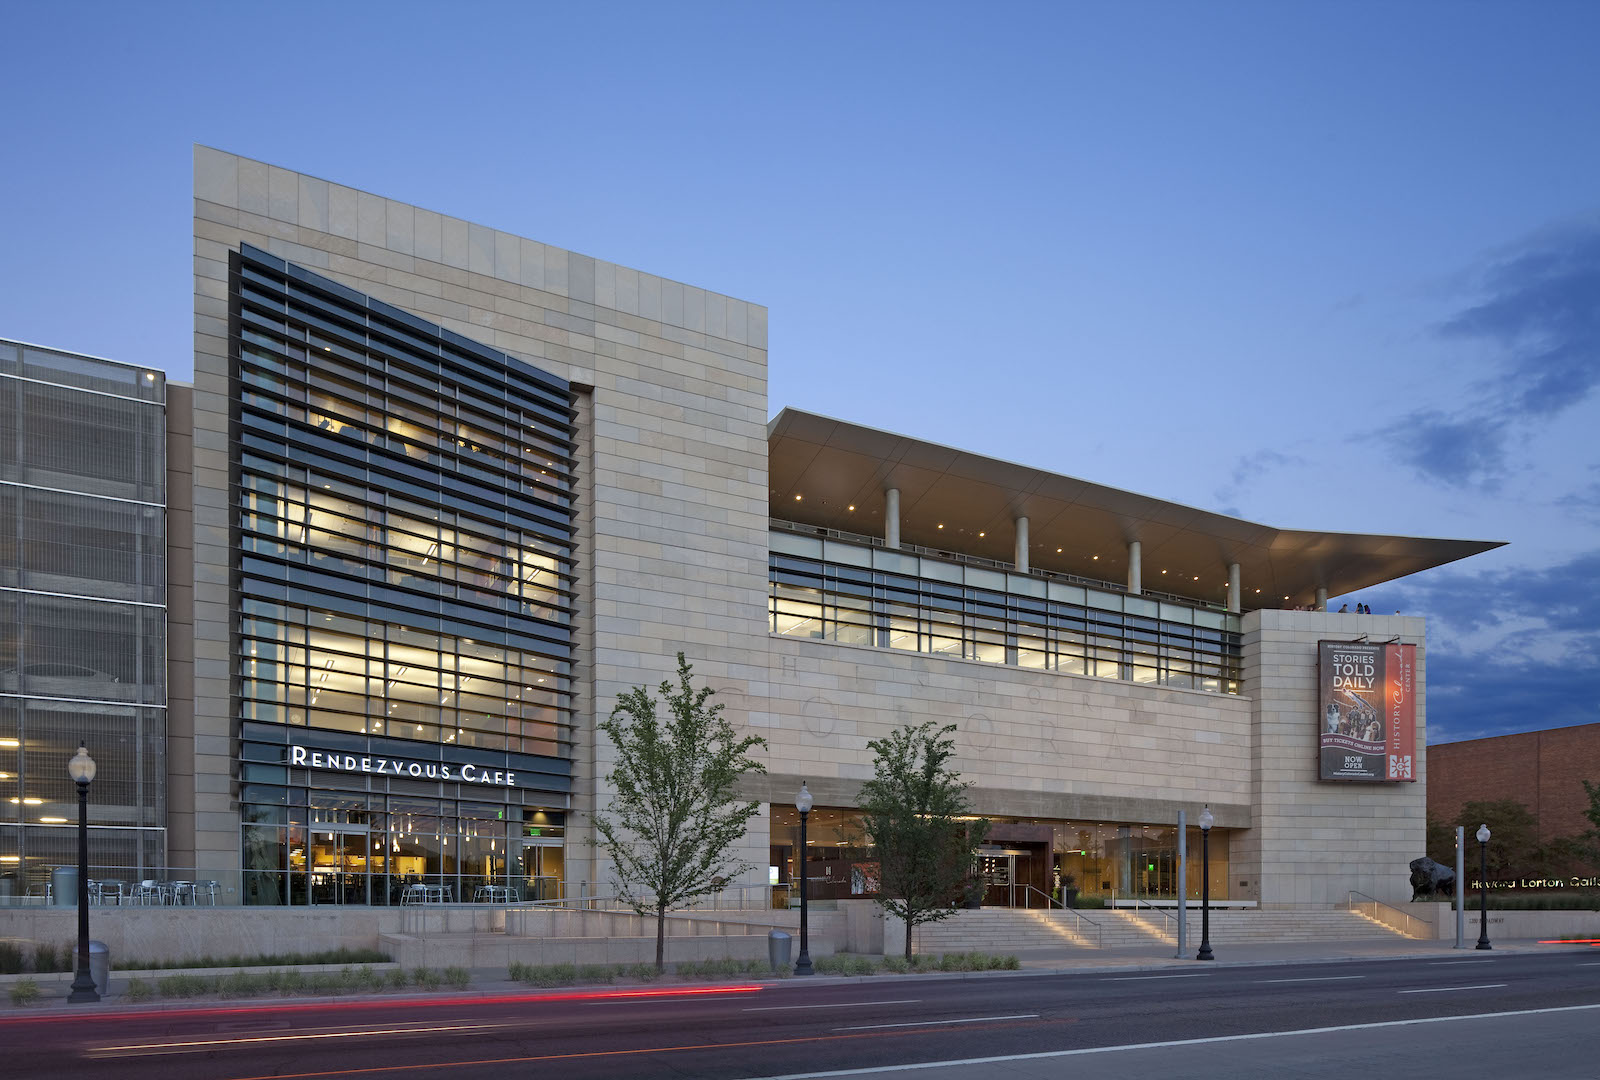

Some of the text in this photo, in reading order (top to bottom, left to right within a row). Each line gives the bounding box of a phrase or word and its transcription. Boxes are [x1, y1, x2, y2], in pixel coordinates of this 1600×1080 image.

[1333, 654, 1375, 664] STORIES
[1333, 664, 1375, 677] TOLD
[1333, 676, 1375, 689] DAILY
[1334, 738, 1354, 746] TICKETS
[1354, 743, 1372, 751] ONLINE
[292, 745, 515, 786] RENDEZVOUS CAFE
[1521, 879, 1563, 888] Lorton
